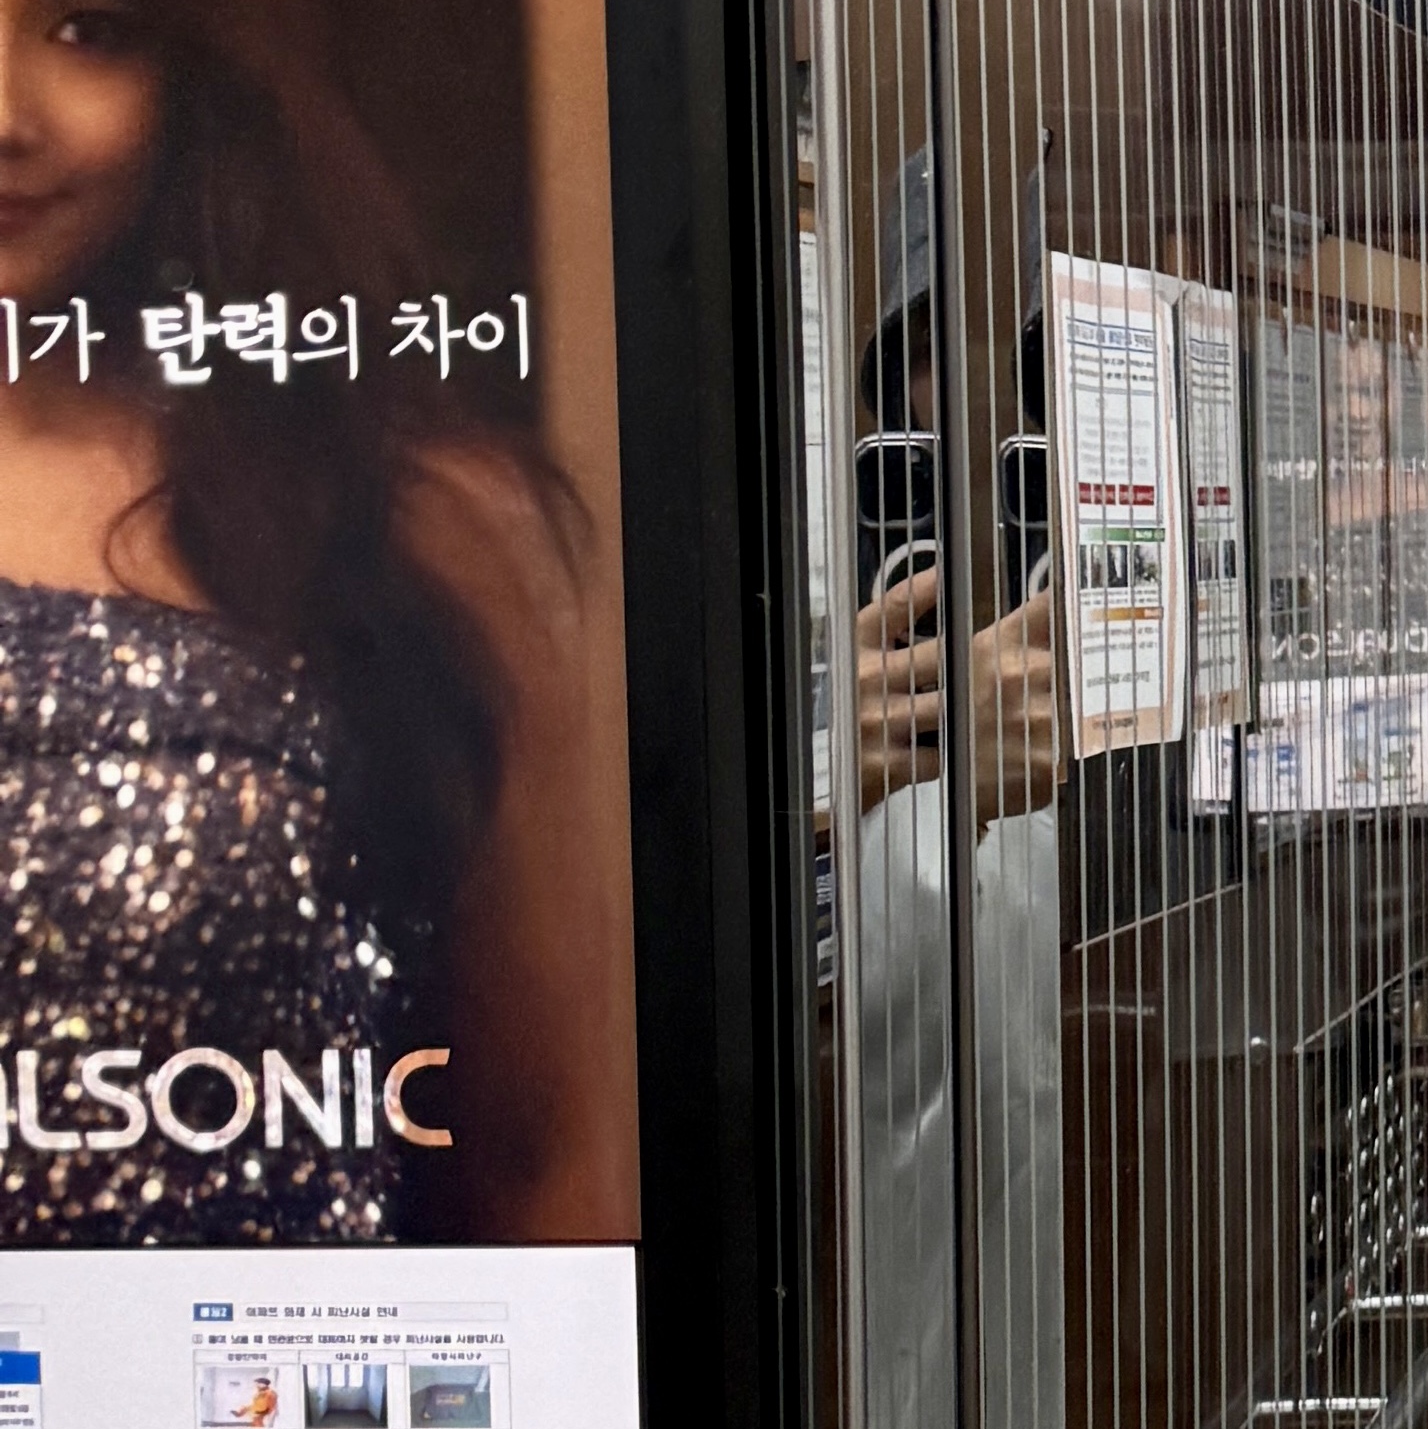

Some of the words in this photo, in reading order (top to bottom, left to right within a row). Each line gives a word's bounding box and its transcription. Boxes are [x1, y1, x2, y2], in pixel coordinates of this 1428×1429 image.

[0, 297, 105, 383] 가
[141, 292, 360, 383] 탄력의
[389, 292, 532, 381] 차이
[0, 1046, 454, 1153] LSONIC
